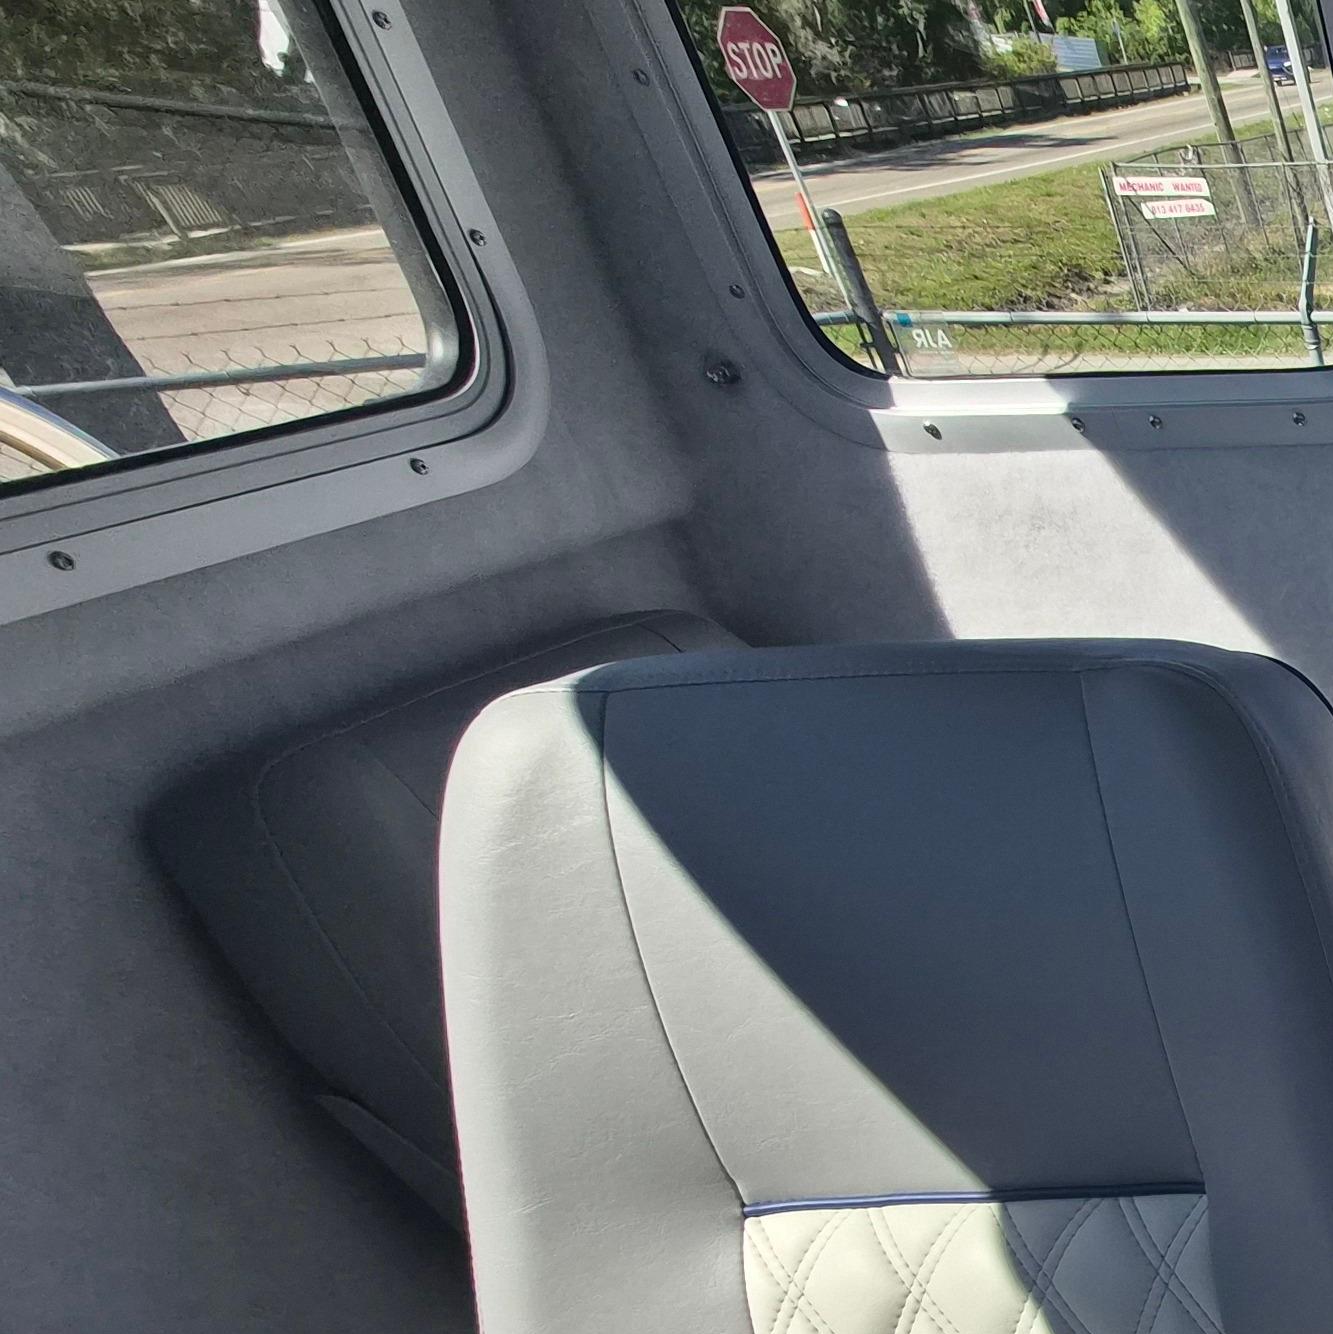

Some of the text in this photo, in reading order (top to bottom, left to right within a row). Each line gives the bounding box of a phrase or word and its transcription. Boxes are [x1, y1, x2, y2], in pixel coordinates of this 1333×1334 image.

[727, 41, 783, 79] STOP
[1119, 182, 1203, 192] MECHANIC WANTED
